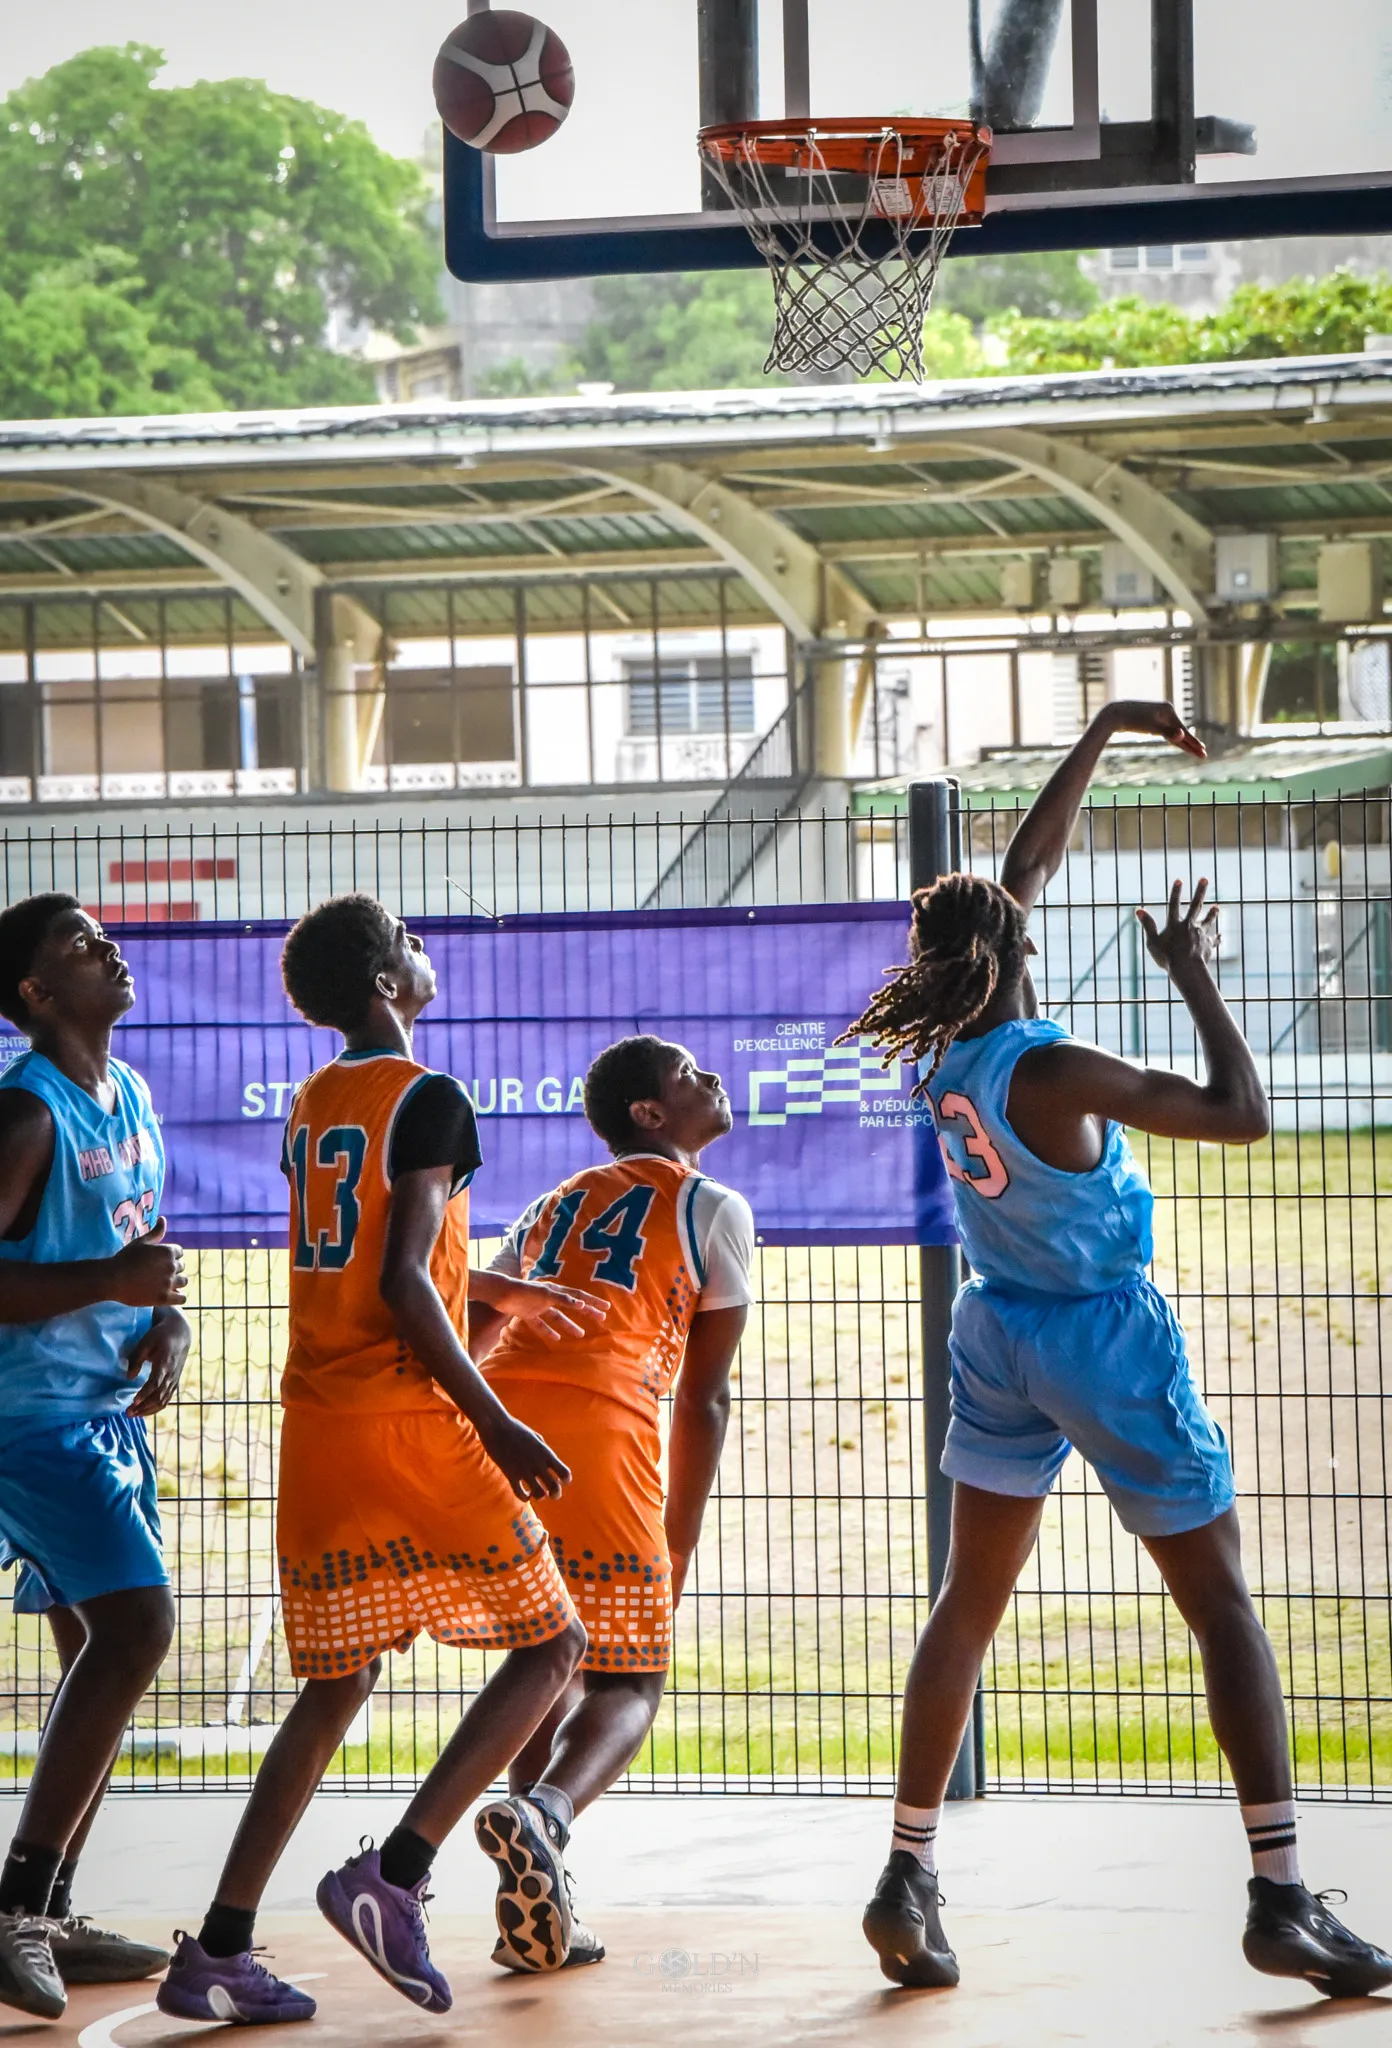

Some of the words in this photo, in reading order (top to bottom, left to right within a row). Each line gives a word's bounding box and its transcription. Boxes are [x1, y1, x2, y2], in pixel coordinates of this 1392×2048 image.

[733, 1038, 826, 1051] D'EXCELLENCE
[775, 1022, 826, 1036] CENTRE
[241, 1082, 299, 1118] ST
[460, 1078, 524, 1115] UR
[859, 1100, 870, 1112] &
[859, 1115, 885, 1128] PAR
[888, 1115, 902, 1127] LE
[905, 1114, 933, 1127] SPO
[924, 1088, 1010, 1199] 3
[79, 1147, 115, 1181] MHB
[291, 1124, 369, 1272] 13
[527, 1183, 658, 1294] 14
